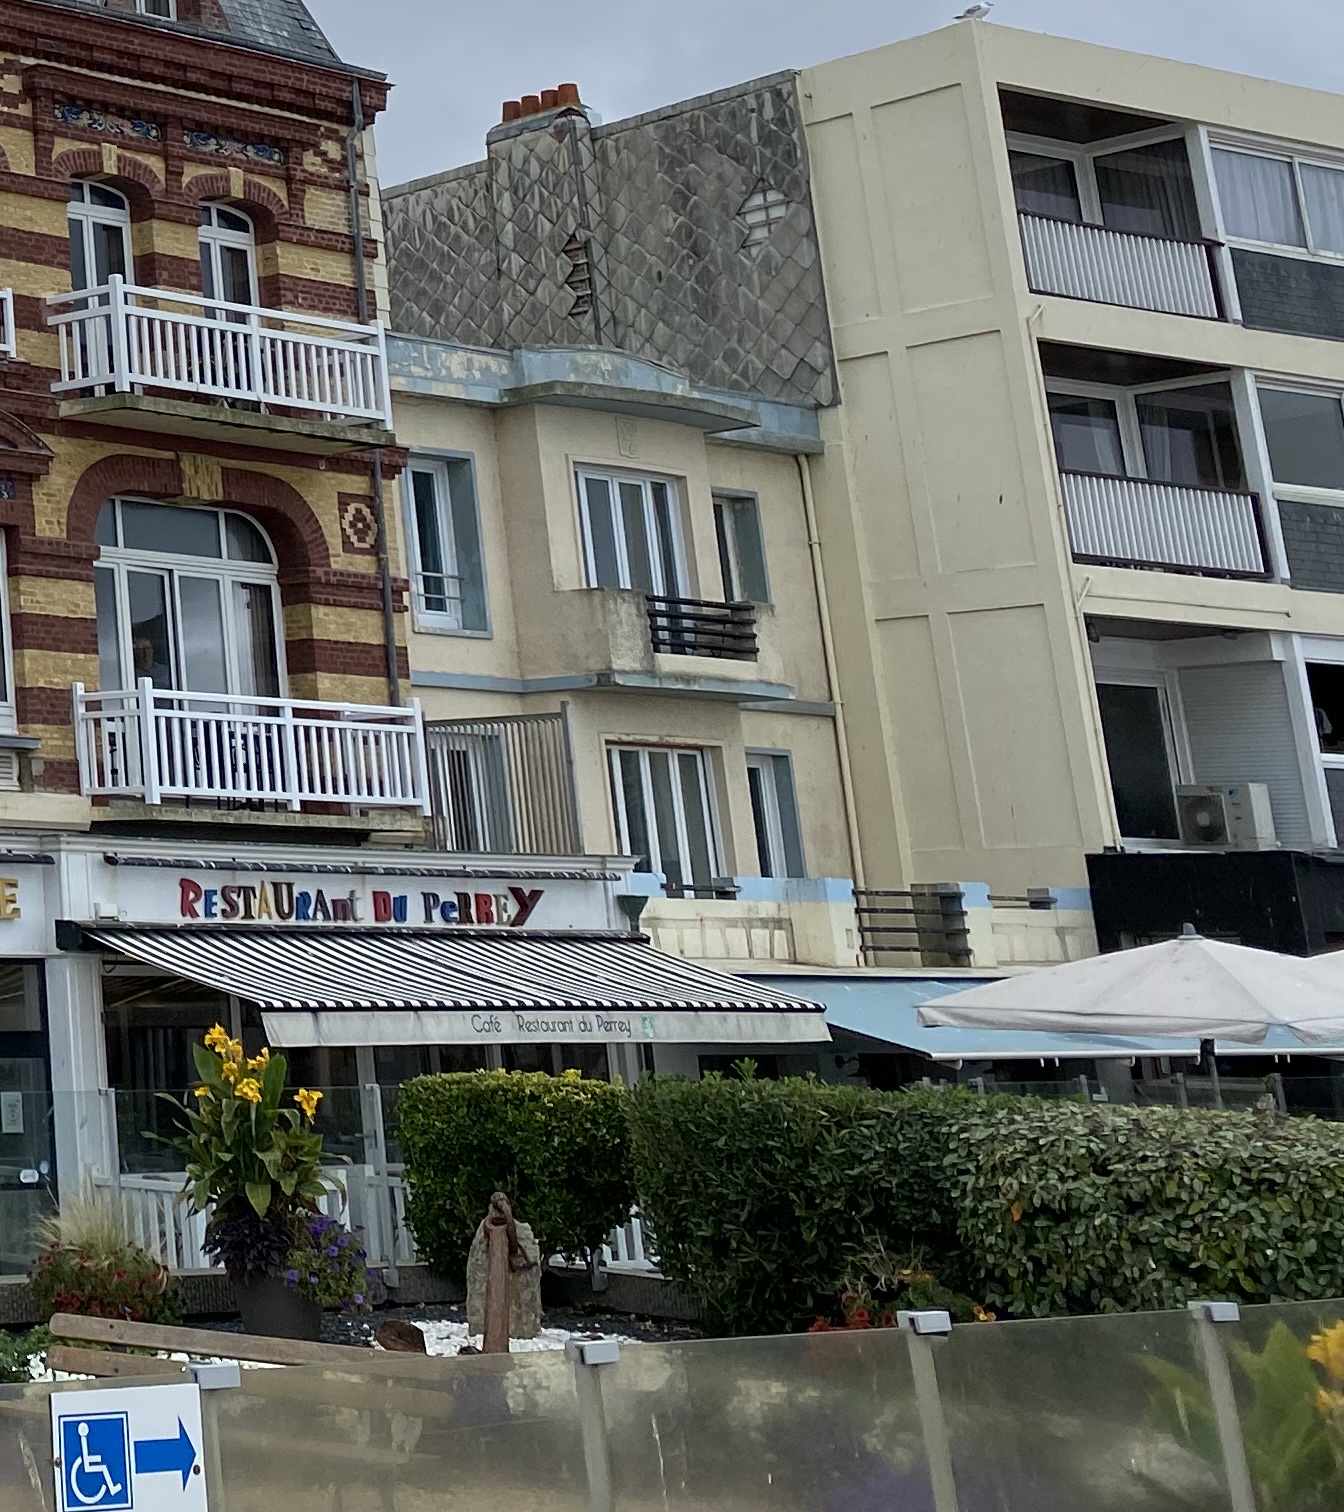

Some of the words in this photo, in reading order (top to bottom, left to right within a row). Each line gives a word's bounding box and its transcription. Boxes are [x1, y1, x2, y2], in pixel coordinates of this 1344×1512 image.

[471, 1014, 502, 1033] Café
[516, 1014, 574, 1032] Restaurant
[578, 1015, 593, 1032] du
[596, 1015, 632, 1038] Perrey
